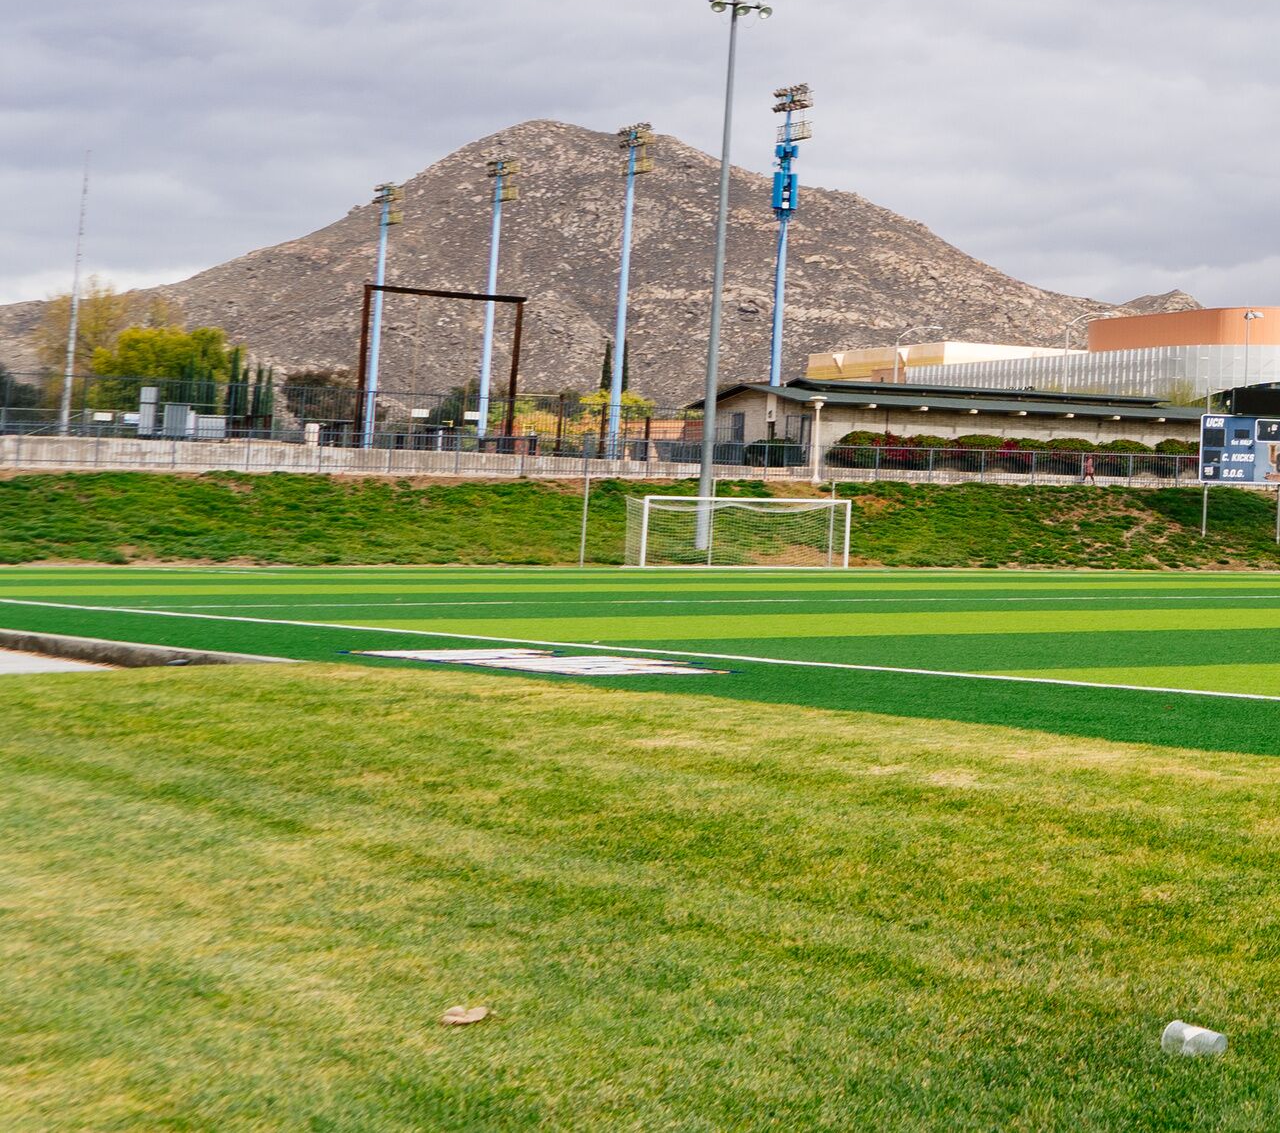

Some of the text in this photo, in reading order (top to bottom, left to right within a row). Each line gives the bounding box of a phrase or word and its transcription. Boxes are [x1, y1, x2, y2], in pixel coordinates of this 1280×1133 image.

[1206, 418, 1224, 427] UCR
[1222, 453, 1254, 462] C. KICKS
[1223, 468, 1244, 477] S.O.G.
